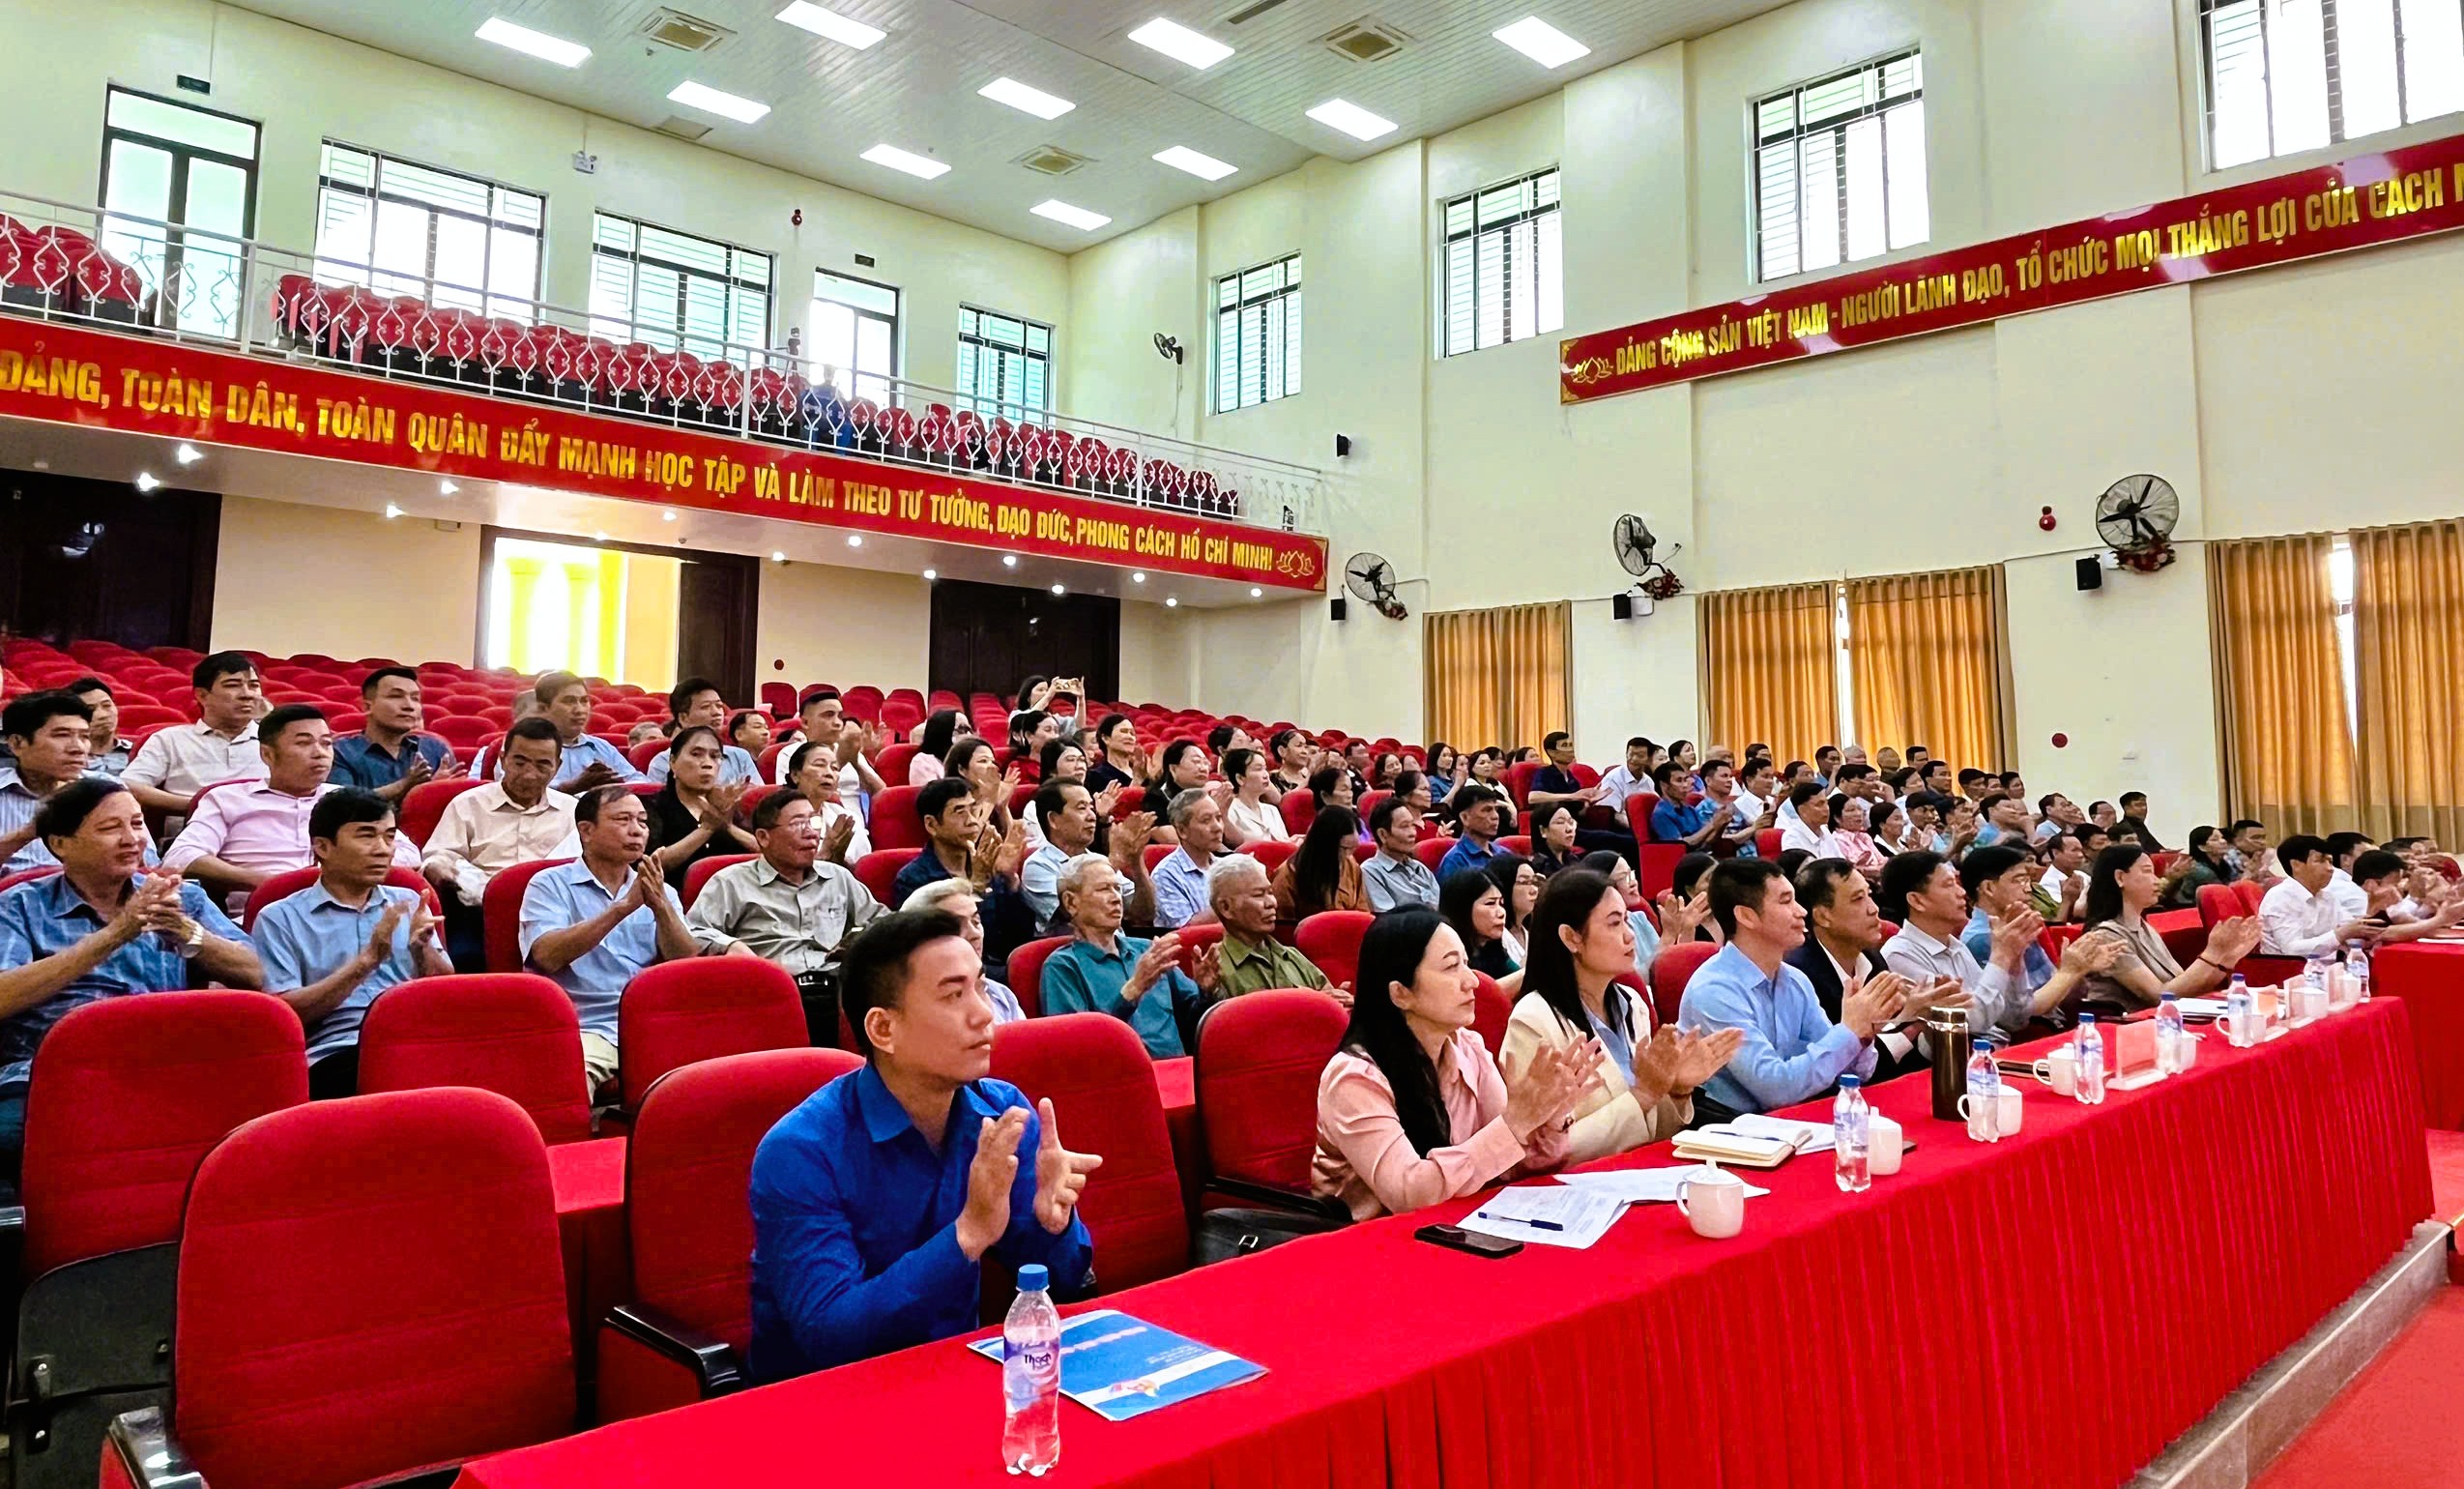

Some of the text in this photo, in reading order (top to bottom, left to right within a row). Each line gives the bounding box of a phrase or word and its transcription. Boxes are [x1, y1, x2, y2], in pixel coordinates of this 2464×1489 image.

[1661, 328, 1707, 368] CỘNG
[1708, 314, 1741, 357] SẢN
[1747, 308, 1782, 349] VIỆT
[1787, 302, 1829, 339] NAM
[1841, 280, 1899, 329] NGƯỜI
[1905, 274, 1957, 315] LÃNH
[1962, 263, 2011, 305] ĐẠO,
[2015, 239, 2043, 291] TỔ
[2048, 236, 2109, 284] CHỨC
[2115, 228, 2160, 273] MỌI
[2167, 202, 2249, 259] THẮNG
[2257, 196, 2297, 246] LỢI
[2305, 177, 2360, 232] CỦA
[120, 367, 213, 419] TOÀN
[316, 395, 395, 445] TOÀN
[408, 412, 488, 458] QUÂN
[500, 417, 551, 466] ĐẨY
[559, 437, 636, 480] MẠNH
[646, 450, 694, 492] HỌC
[704, 454, 746, 499] TẬP
[754, 462, 781, 501] VÀ
[789, 468, 835, 509] LÀM
[843, 481, 891, 516] THEO
[898, 489, 924, 520] TƯ
[930, 487, 994, 534] TƯỞNG,
[1036, 508, 1074, 546] ĐỨC,
[1077, 517, 1129, 551] PHONG
[1135, 524, 1175, 557] CÁCH
[1204, 535, 1229, 565] CHÍ
[1232, 541, 1273, 571] MINH!
